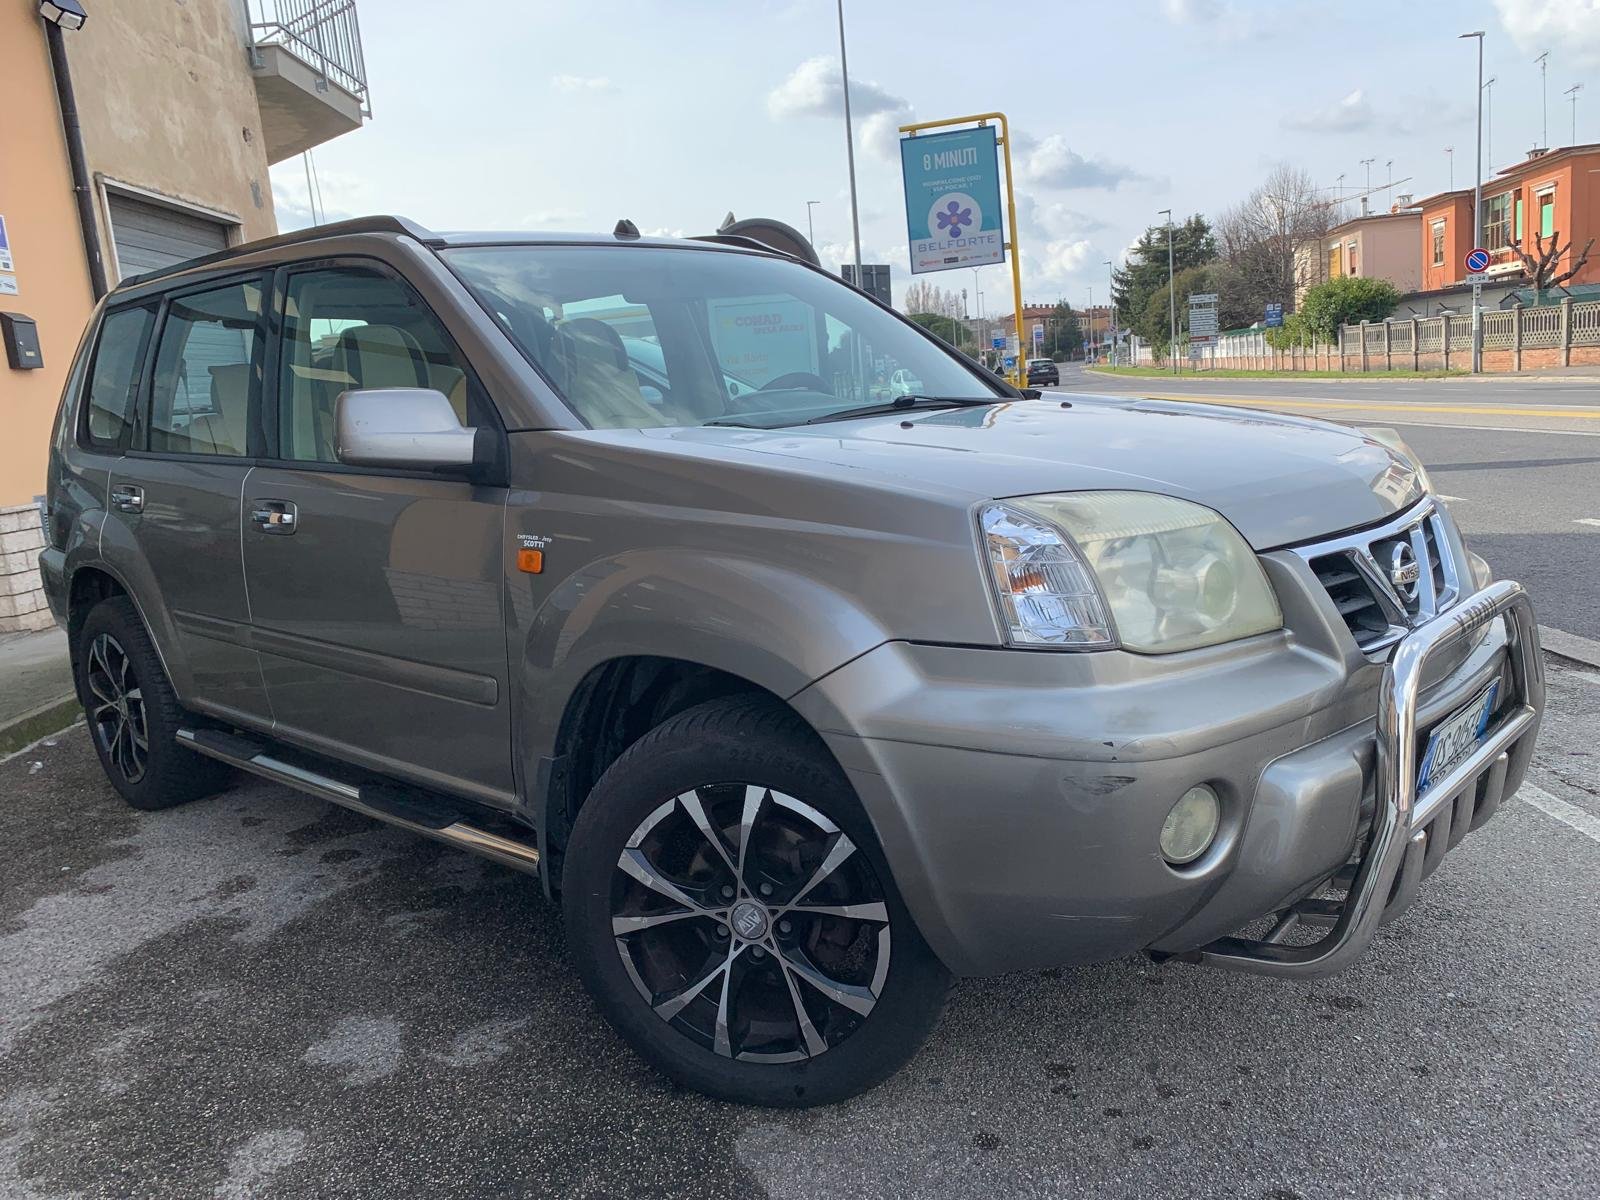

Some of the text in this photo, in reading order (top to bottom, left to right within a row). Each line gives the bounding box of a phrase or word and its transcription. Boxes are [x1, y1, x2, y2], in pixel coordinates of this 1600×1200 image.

[923, 147, 977, 171] 8 MINUTI
[918, 235, 995, 252] BELFORTE
[523, 540, 545, 548] SCOTTI
